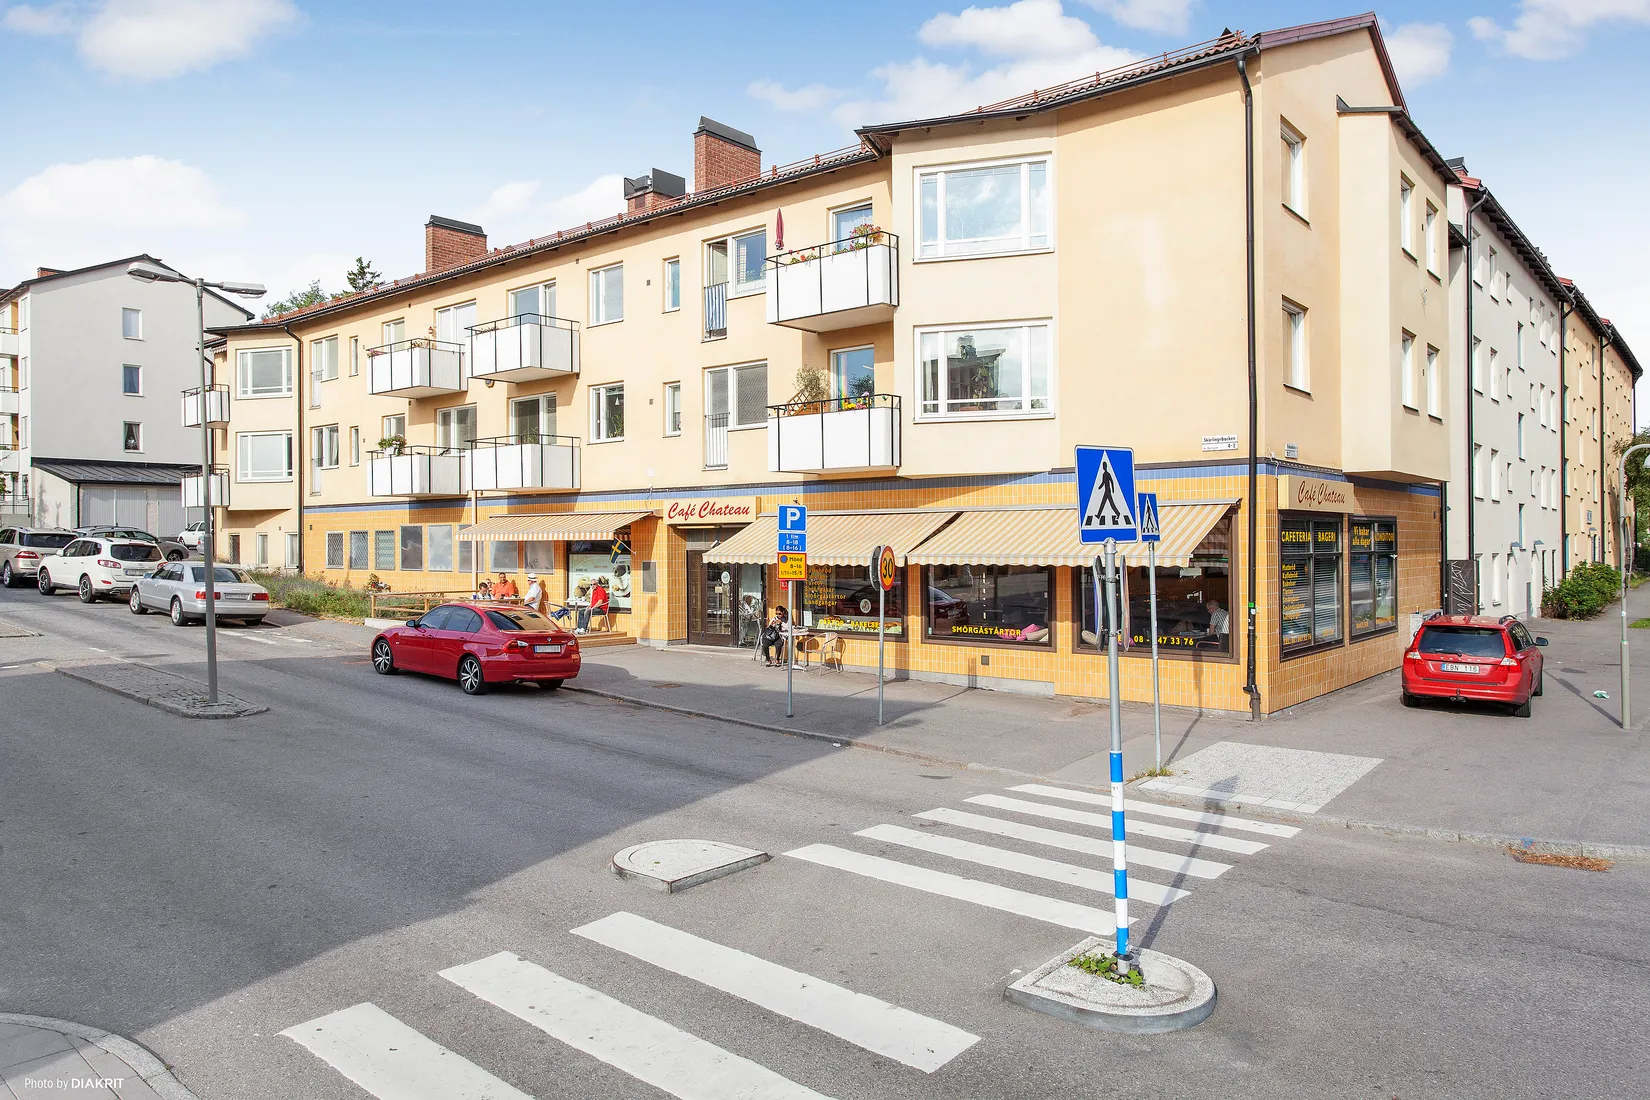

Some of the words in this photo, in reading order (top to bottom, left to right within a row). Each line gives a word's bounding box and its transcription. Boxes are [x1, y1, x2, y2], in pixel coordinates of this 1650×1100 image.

[1297, 480, 1316, 507] Café
[1318, 483, 1346, 505] Chateau
[668, 502, 697, 521] Café
[698, 501, 751, 519] Chateau
[786, 507, 800, 529] P
[1281, 531, 1311, 542] CAFETERIA
[882, 558, 894, 578] 30
[952, 625, 1022, 636] SMÖRGÅSTÅRTOR
[1184, 638, 1194, 646] 76
